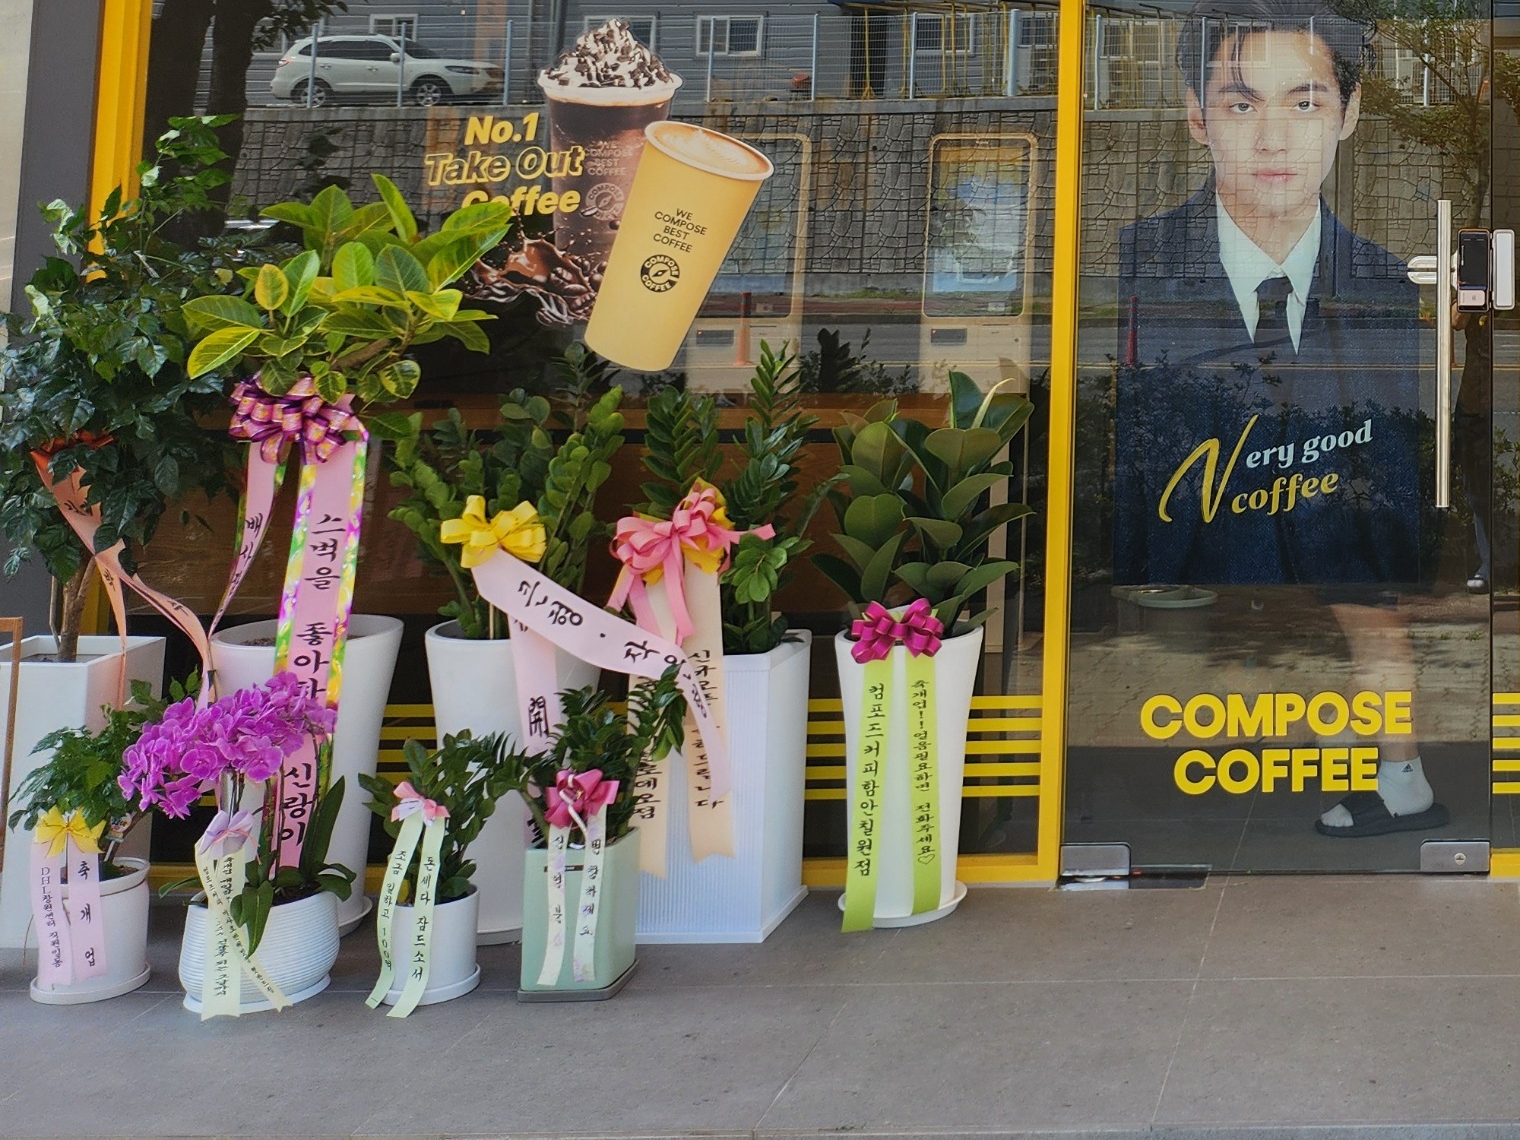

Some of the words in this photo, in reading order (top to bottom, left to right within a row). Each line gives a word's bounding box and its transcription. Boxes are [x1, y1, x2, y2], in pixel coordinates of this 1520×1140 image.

[464, 112, 540, 145] No.1
[425, 151, 511, 186] Take
[516, 145, 586, 180] Out
[655, 211, 708, 235] COMPOSE
[663, 225, 690, 240] BEST
[676, 208, 693, 220] WE
[653, 233, 693, 253] COFFEE
[642, 274, 672, 291] COFFEE
[644, 255, 680, 276] COMPOSE
[1302, 418, 1374, 464] good
[1231, 471, 1339, 516] coffee
[303, 513, 347, 591] 스벅을
[1140, 690, 1412, 740] COMPOSE
[854, 682, 886, 877] 컴포즈커피함안칠원점
[1174, 746, 1380, 795] COFFEE
[279, 762, 317, 846] 신랑이
